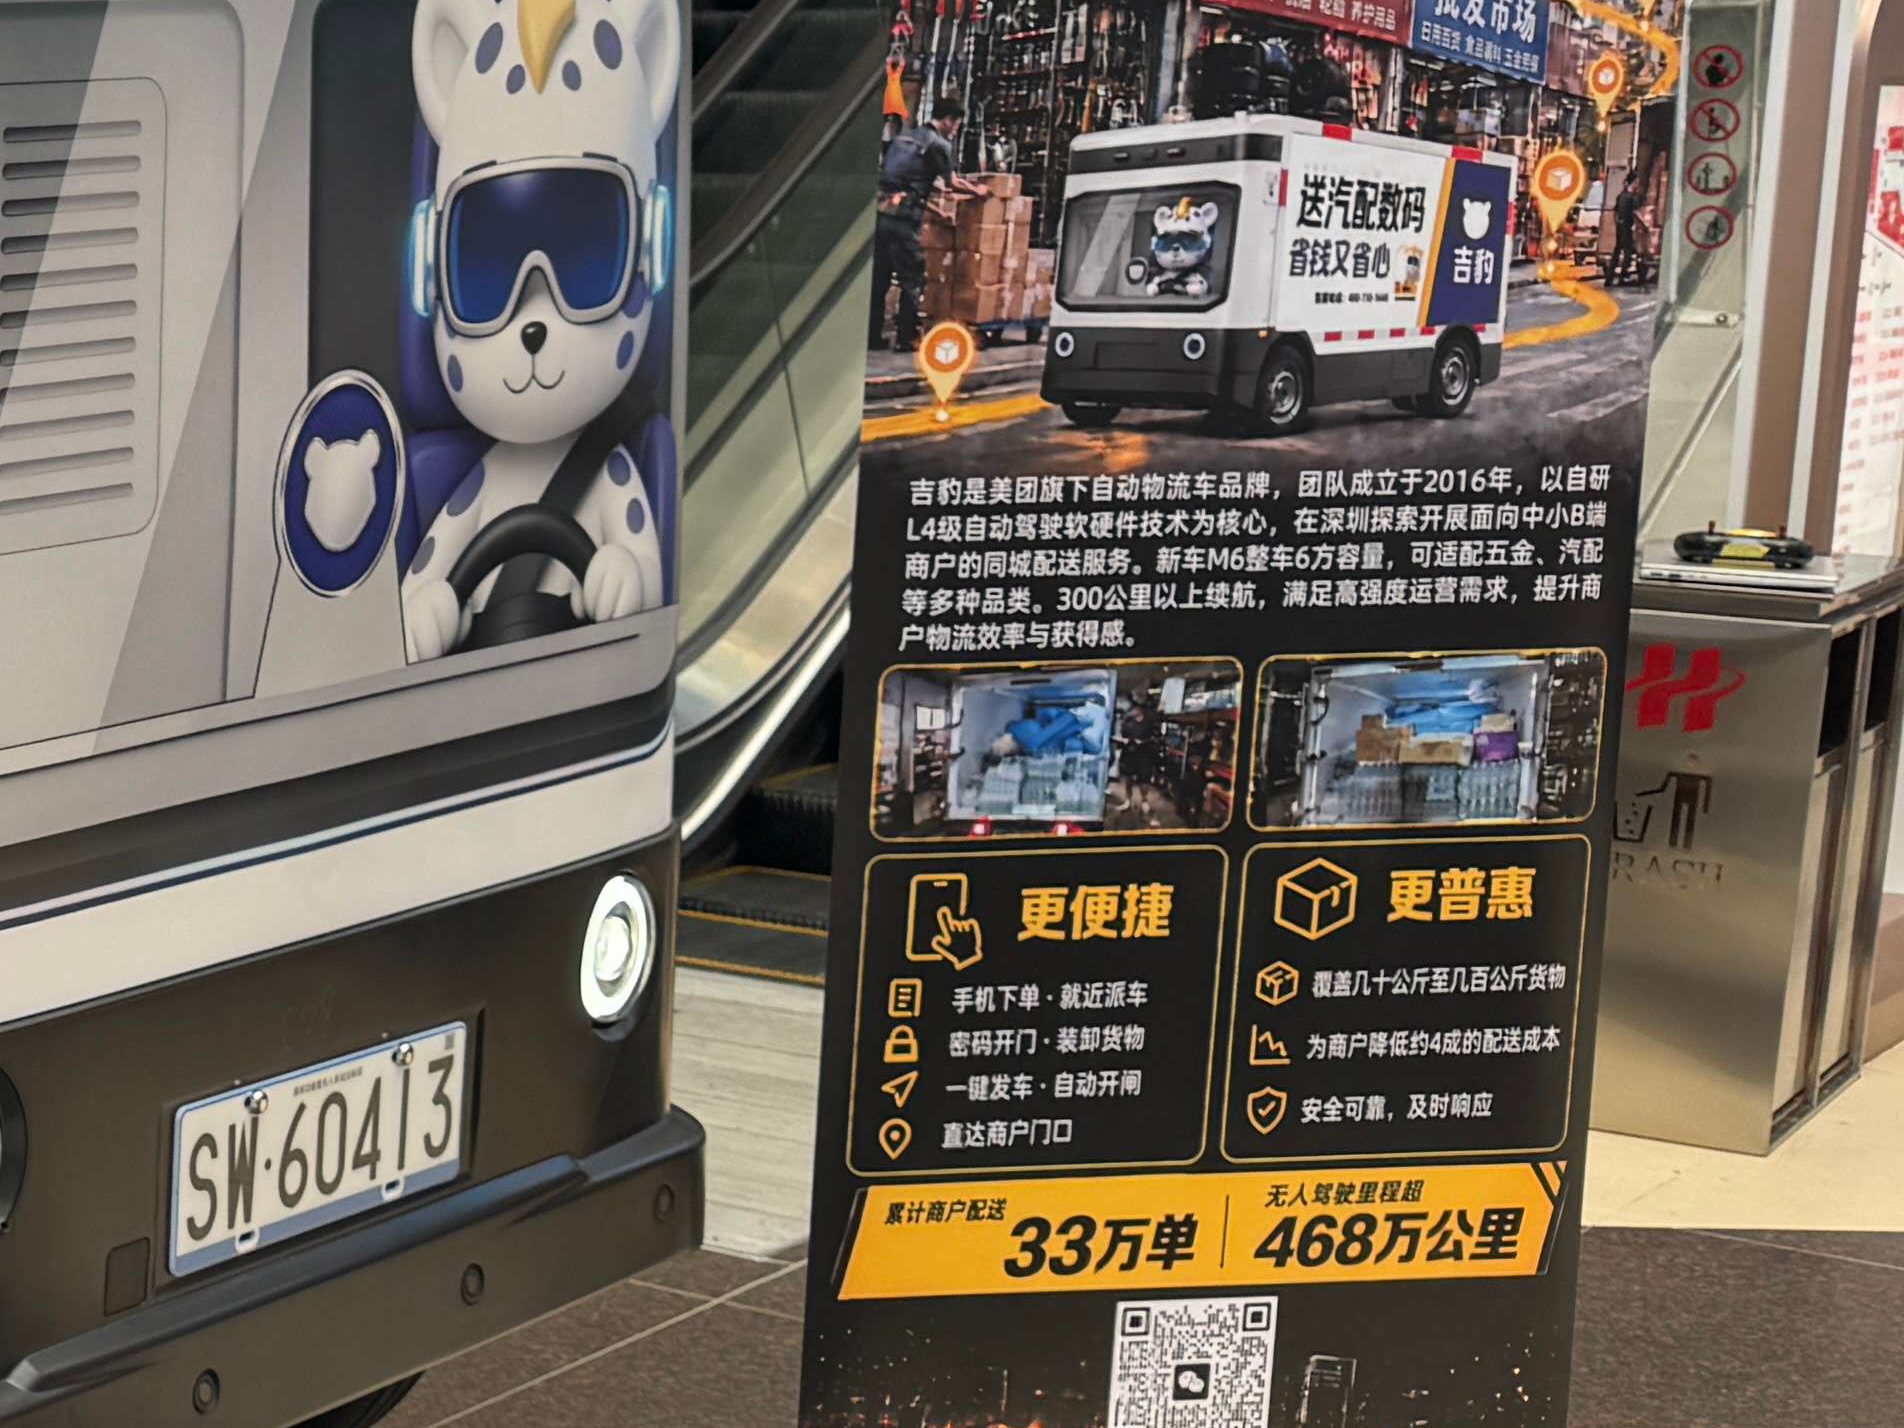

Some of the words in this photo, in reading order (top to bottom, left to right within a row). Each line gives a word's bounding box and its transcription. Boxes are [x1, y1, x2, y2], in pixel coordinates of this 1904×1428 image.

[1297, 172, 1426, 233] 送汽配数码
[1289, 238, 1391, 279] 省钱又省心
[1453, 245, 1495, 285] 吉豹
[898, 619, 1135, 652] 户物流效率与获得感。
[1017, 882, 1174, 941] 更便捷
[1387, 866, 1536, 922] 更普惠
[1312, 965, 1567, 999] 覆盖几十公斤至几百公斤货物
[1306, 1026, 1561, 1060] 为商户降低约4成的配送成本
[1300, 1092, 1494, 1124] 安全可靠，及时响应
[941, 1119, 1073, 1149] 直达商户门口
[884, 1198, 1007, 1226] 累计商户配送
[1264, 1180, 1423, 1209] 无人驾驶里程超
[1004, 1213, 1199, 1278] 33万单
[1254, 1206, 1525, 1269] 468万公里
